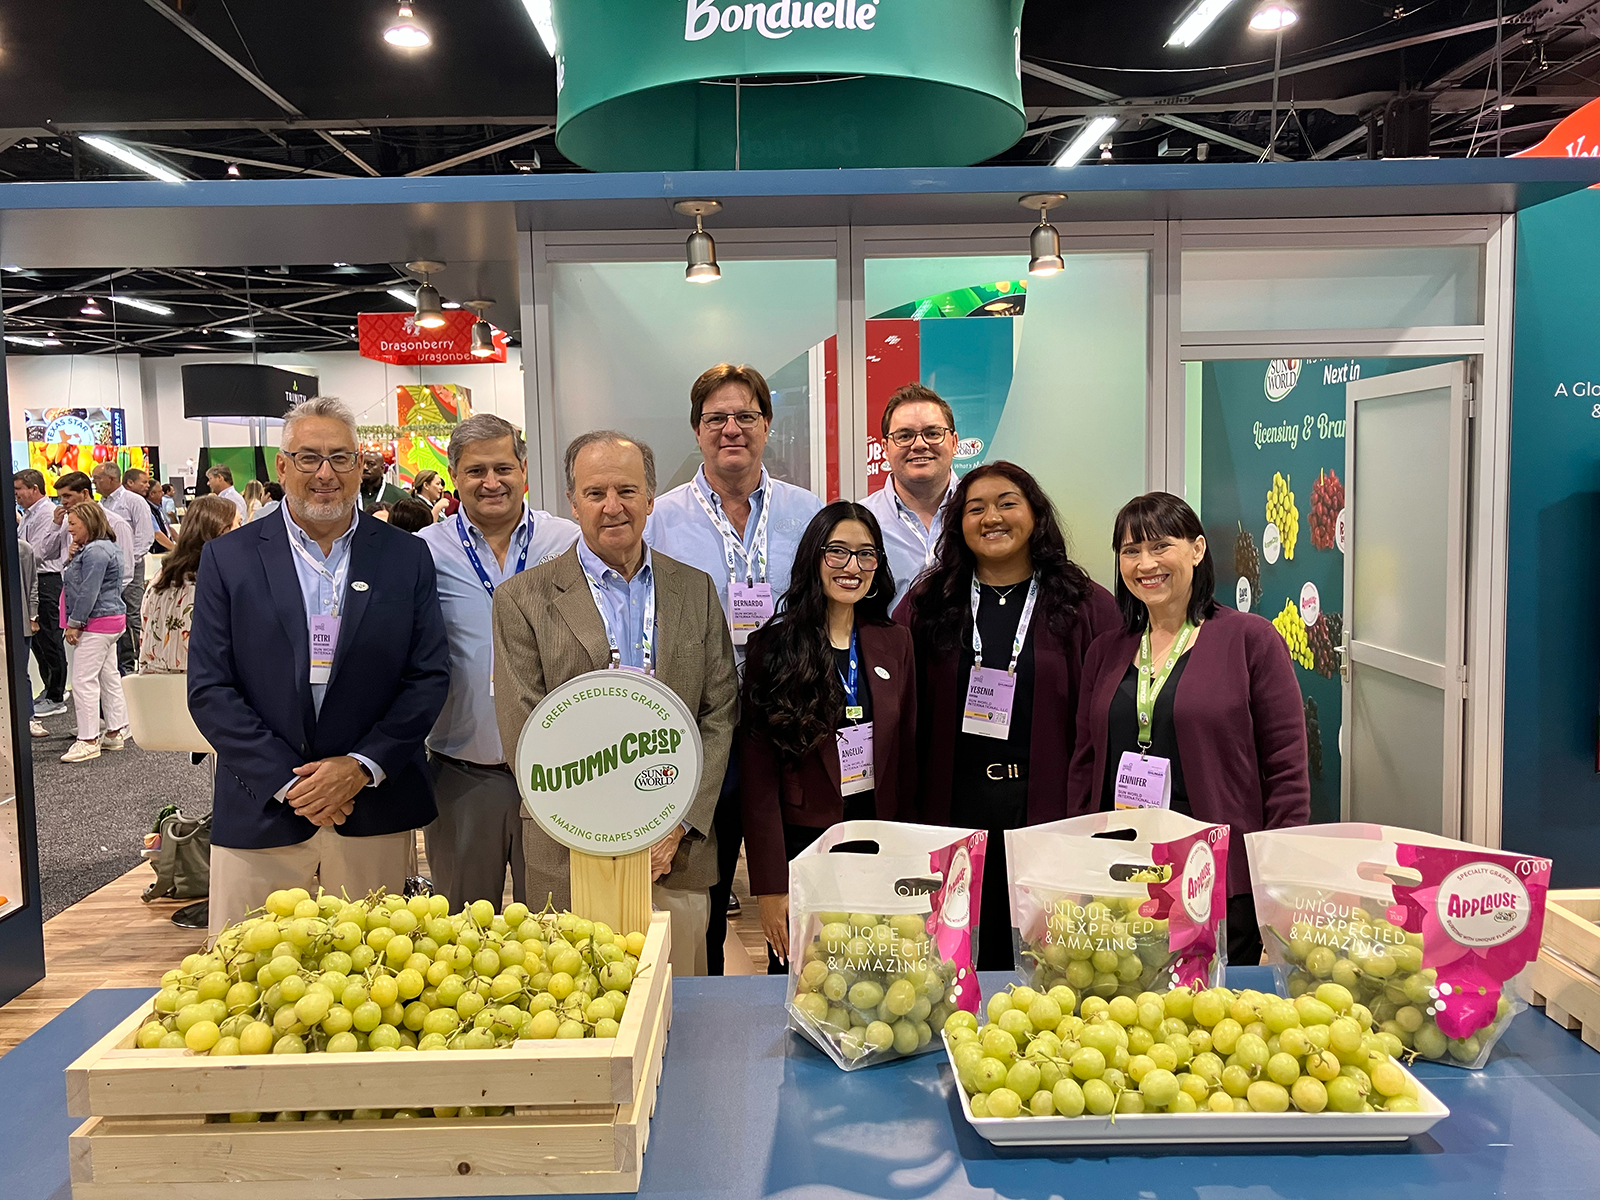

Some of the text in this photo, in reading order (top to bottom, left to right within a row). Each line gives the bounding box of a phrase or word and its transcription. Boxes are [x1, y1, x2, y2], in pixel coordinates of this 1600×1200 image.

[684, 0, 877, 41] Bonduelle
[380, 340, 454, 352] Dragonberry
[1270, 359, 1288, 375] SUN
[1323, 359, 1360, 385] Next in
[1268, 371, 1297, 391] WORLD
[1554, 382, 1568, 397] A
[285, 391, 307, 402] TRINITY
[47, 418, 89, 442] TEXAS STAR
[1253, 420, 1299, 450] Licensing
[1302, 414, 1314, 441] &
[733, 599, 764, 607] BERNARDO
[313, 633, 331, 643] PETRI
[970, 685, 994, 697] YESENIA
[541, 687, 671, 730] GREEN SEEDLESS GRAPES
[638, 777, 674, 787] WORLD
[641, 769, 663, 780] SUN
[1119, 774, 1147, 787] JENNIFER
[550, 802, 676, 843] AMAZING GRAPES SINCE 1976
[1456, 868, 1512, 885] SPECIALTY GRAPES
[1447, 892, 1517, 918] APPLAUSE
[1045, 916, 1154, 936] UNEXPECTED
[1292, 912, 1405, 945] UNEXPECTED
[1496, 925, 1517, 939] FLAVORS
[827, 940, 930, 957] UNEXPECTE
[1045, 930, 1138, 952] & AMAZING
[1289, 926, 1386, 957] & AMAZING
[828, 956, 927, 973] & AMAZING
